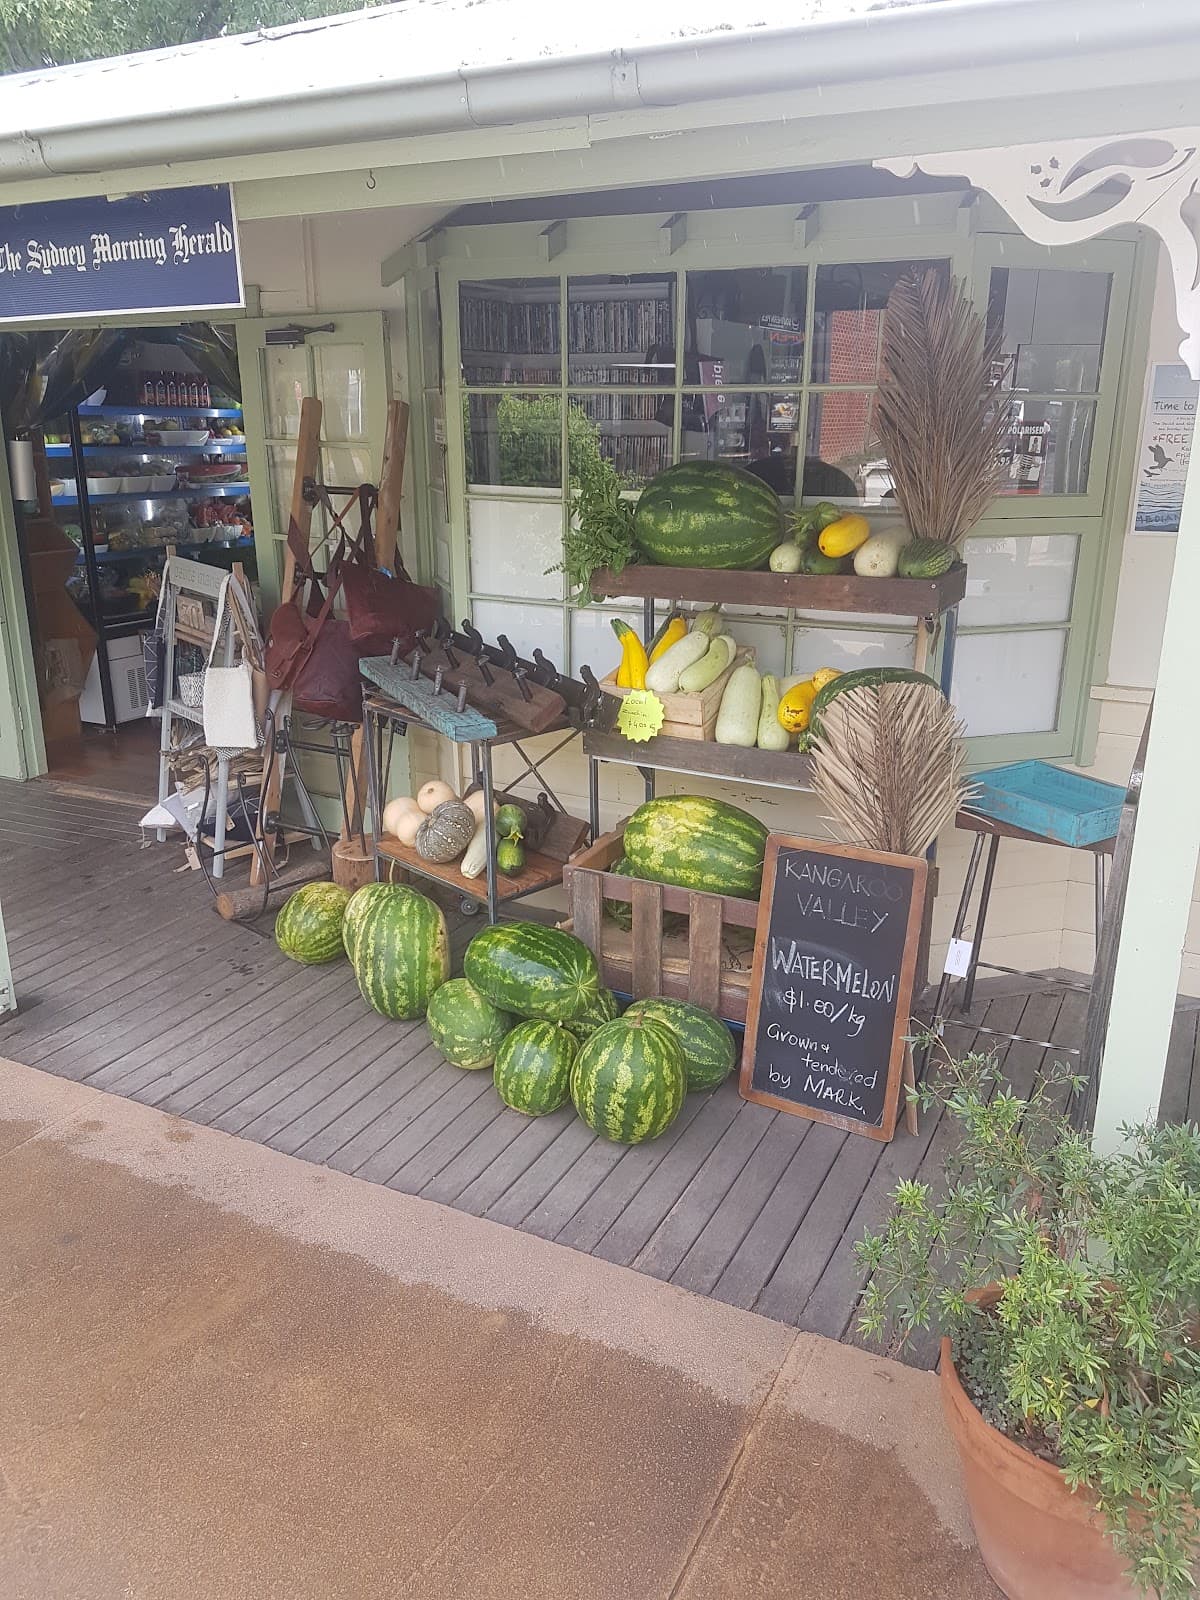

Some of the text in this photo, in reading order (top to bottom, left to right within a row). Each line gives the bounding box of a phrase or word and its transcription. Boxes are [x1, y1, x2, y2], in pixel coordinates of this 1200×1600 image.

[26, 239, 87, 275] Sydney
[90, 232, 167, 271] Morning
[169, 221, 233, 263] Herald
[1154, 401, 1194, 412] Time to
[797, 893, 889, 933] VALLEY
[772, 936, 896, 1003] WATERMELON
[766, 1023, 818, 1051] Grown
[769, 1063, 791, 1089] by
